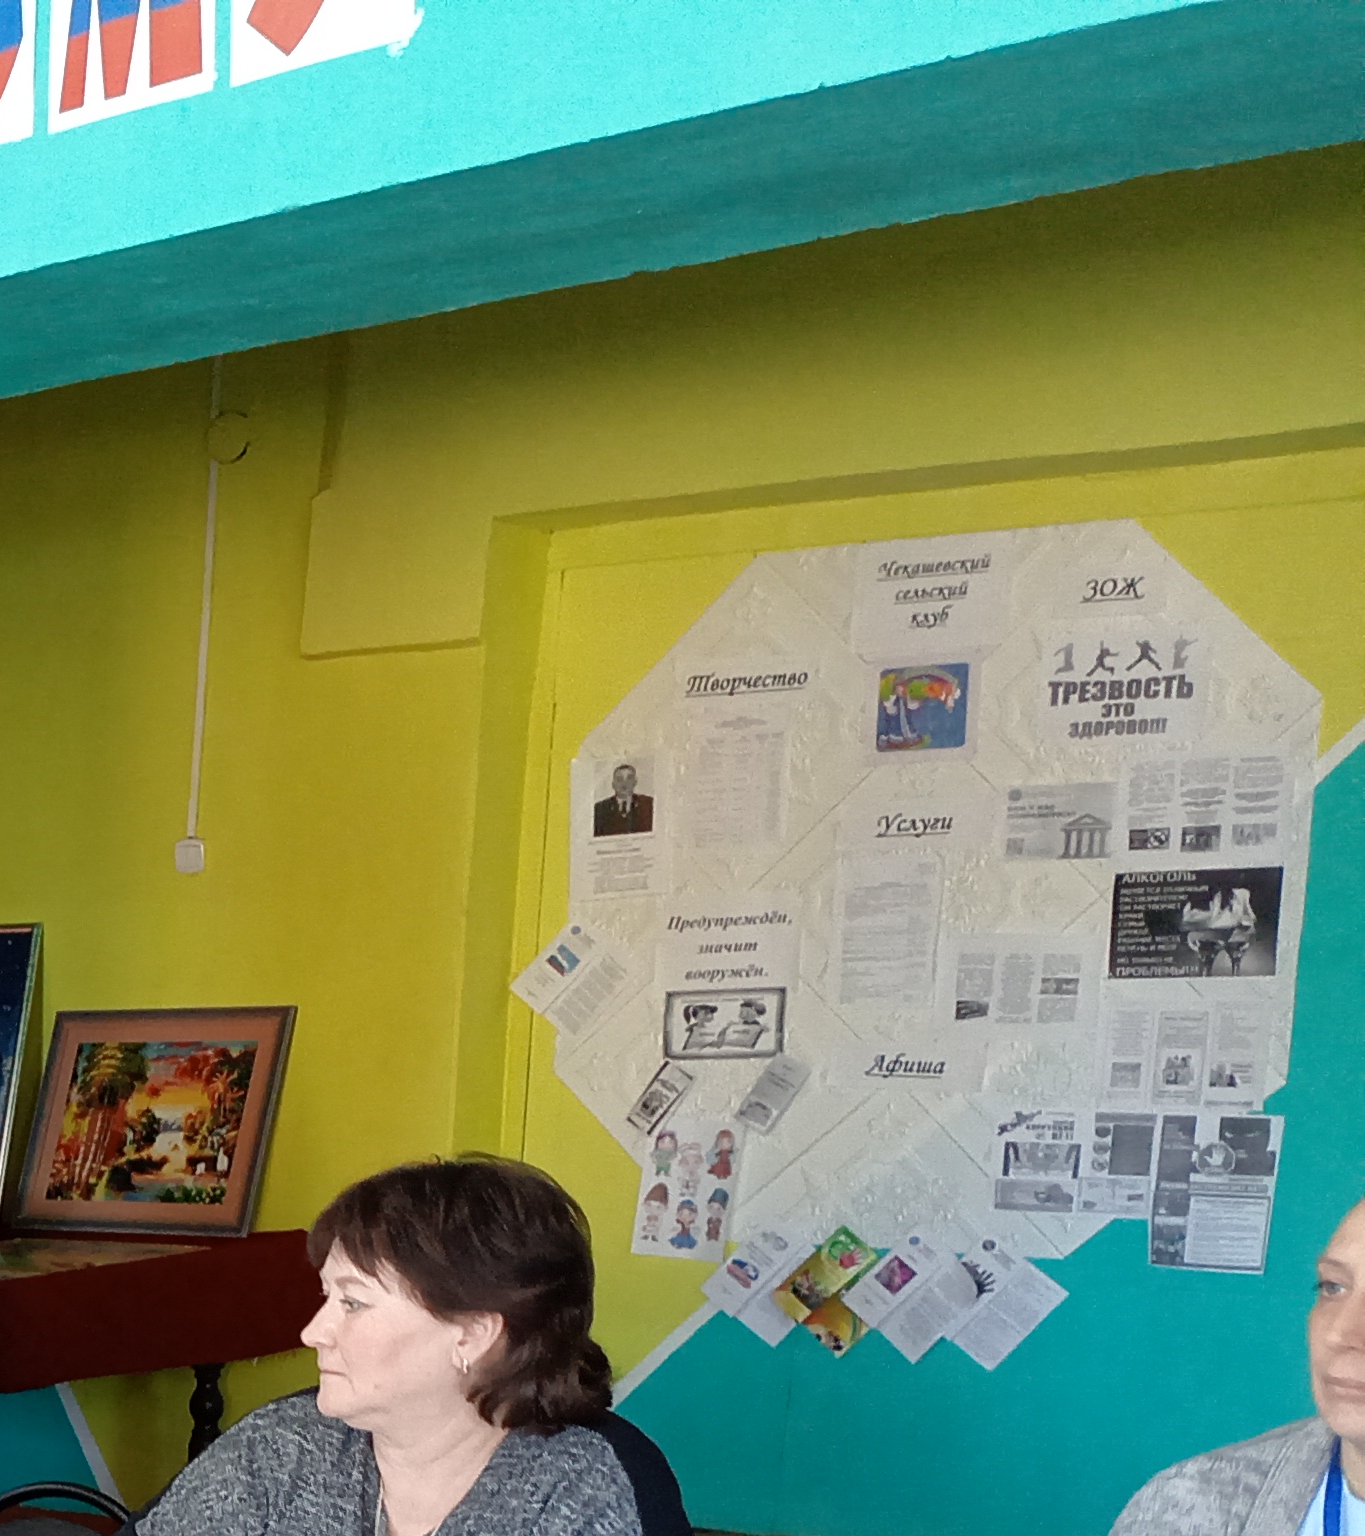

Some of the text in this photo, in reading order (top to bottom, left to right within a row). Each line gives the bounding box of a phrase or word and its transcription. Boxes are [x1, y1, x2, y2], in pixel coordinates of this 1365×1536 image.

[895, 581, 968, 602] сельский
[1084, 576, 1145, 602] ЗОЖ
[910, 605, 953, 629] клуб
[686, 670, 808, 695] Творчество
[1048, 674, 1194, 706] ТРЕЗВОСТЬ
[1101, 703, 1135, 718] ЭТО
[877, 813, 953, 837] Услуги
[666, 911, 793, 933] Предупреждён,
[697, 941, 758, 955] значит
[685, 963, 769, 982] вооружён.
[867, 1052, 945, 1078] Афиша
